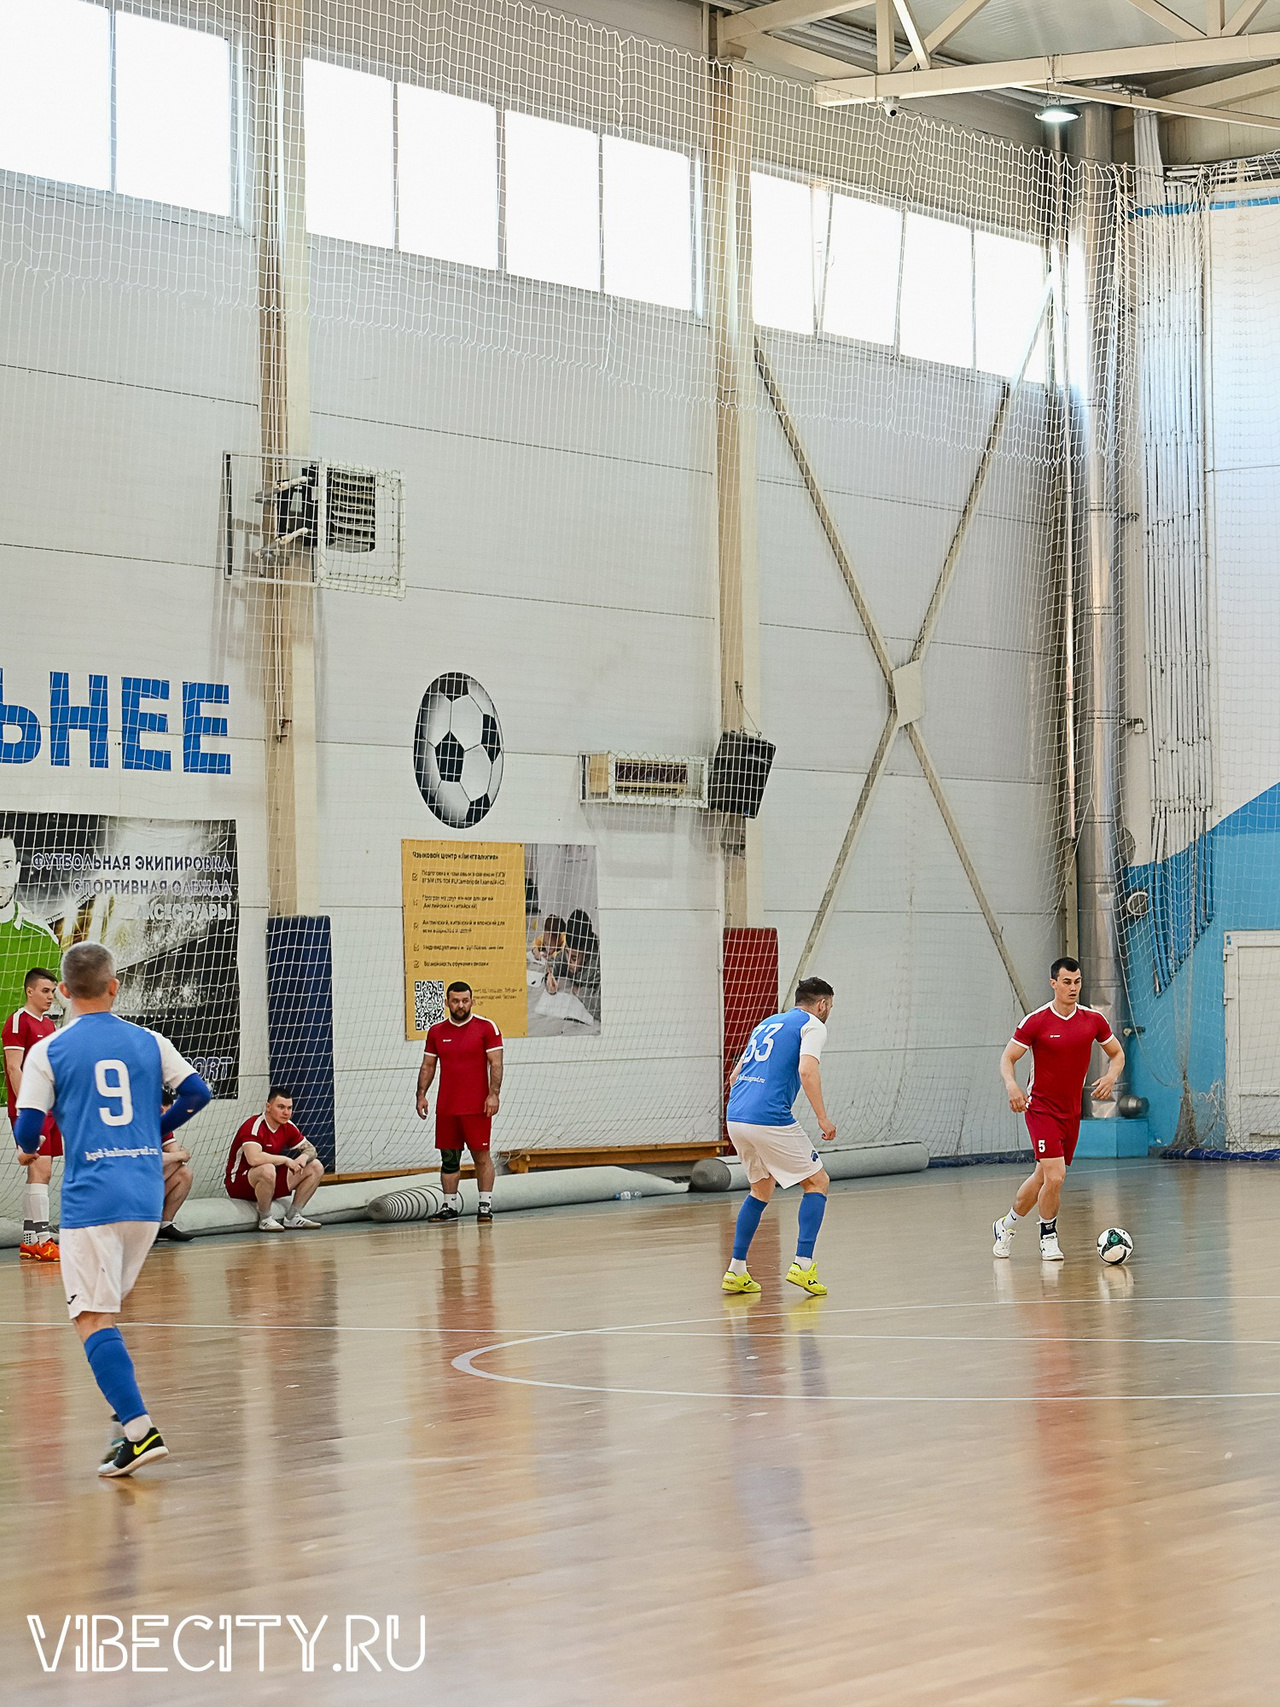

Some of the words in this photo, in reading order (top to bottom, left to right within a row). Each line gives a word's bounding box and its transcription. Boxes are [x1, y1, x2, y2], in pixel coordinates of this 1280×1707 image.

[32, 853, 131, 871] ФУТБОЛЬНАЯ
[135, 855, 231, 872] ЭКИПИРОВКА
[72, 880, 167, 896] СПОРТИВНАЯ
[172, 880, 232, 897] ОДЕЖДА
[742, 1023, 785, 1063] 33
[94, 1059, 133, 1127] 9
[1038, 1139, 1046, 1153] 5
